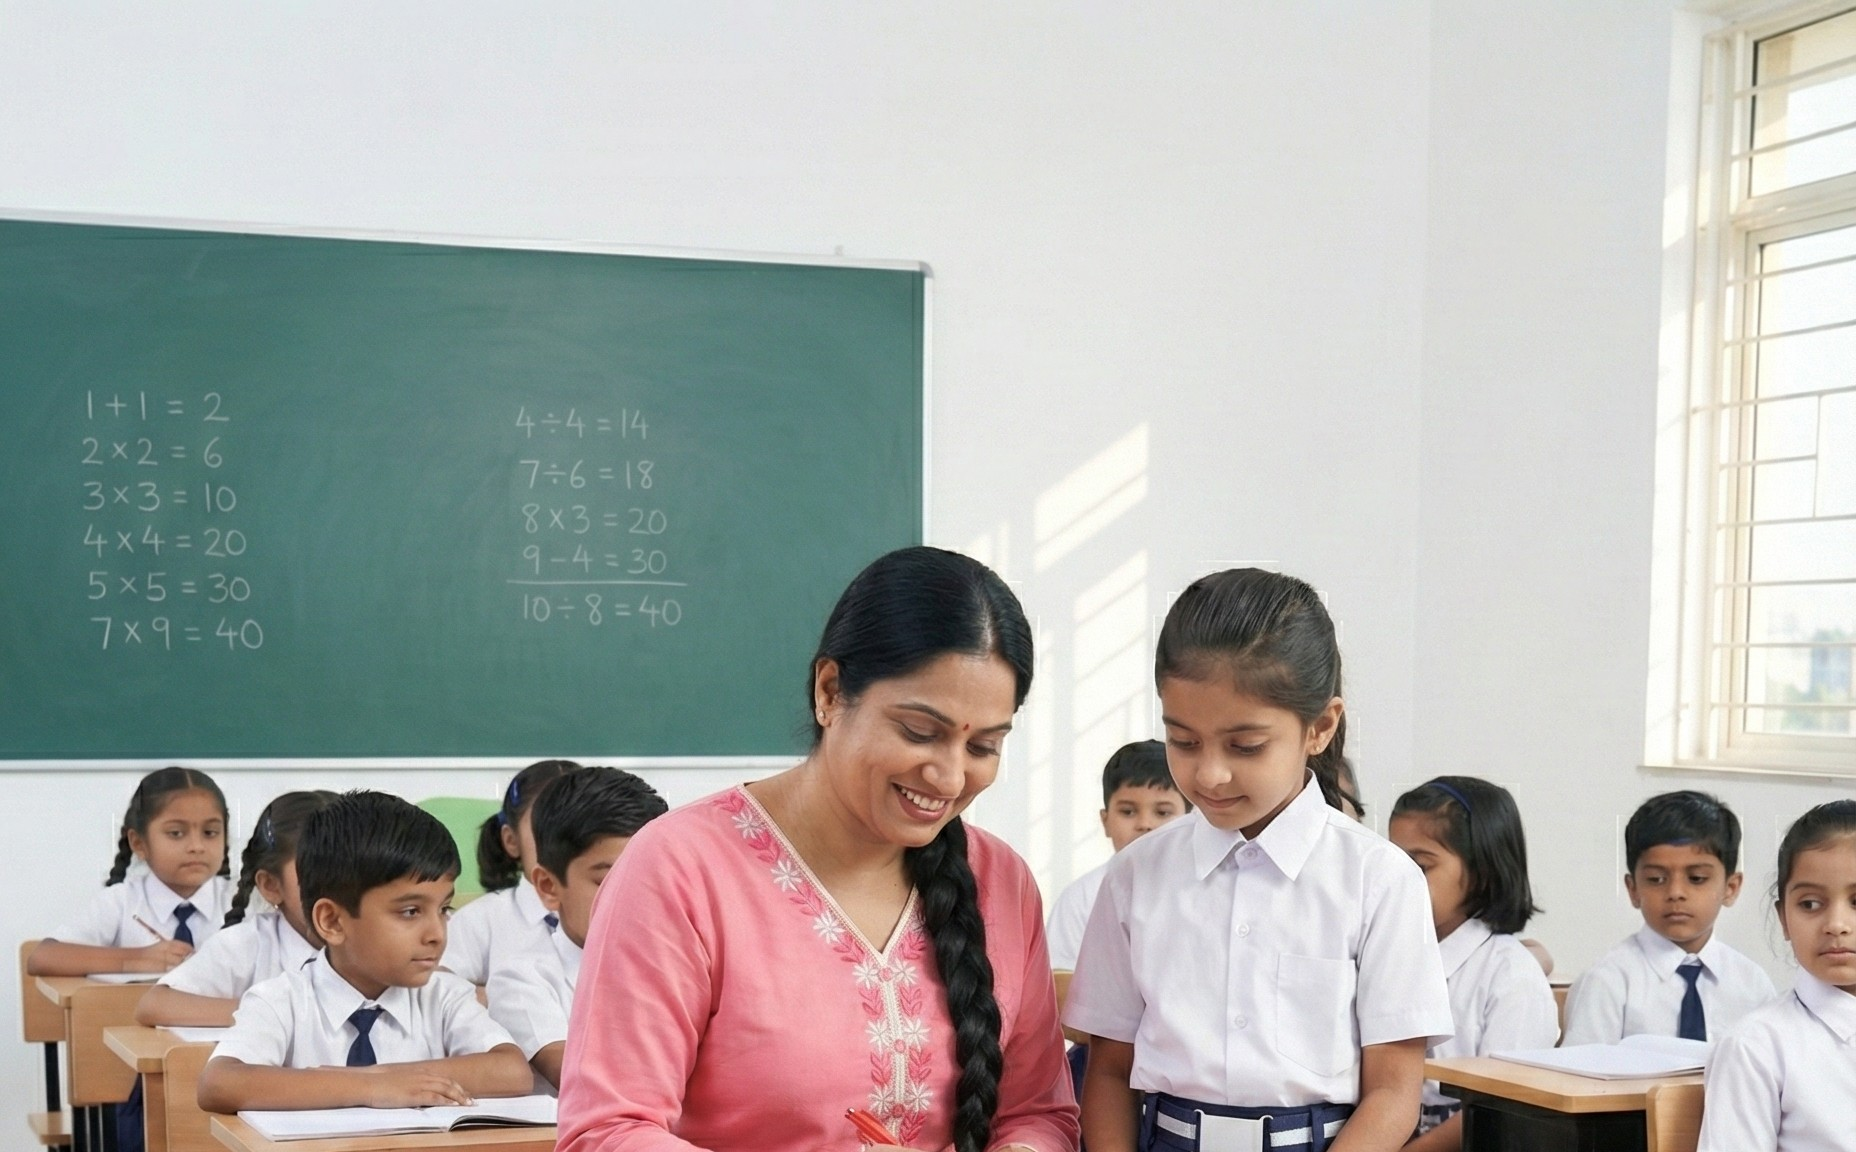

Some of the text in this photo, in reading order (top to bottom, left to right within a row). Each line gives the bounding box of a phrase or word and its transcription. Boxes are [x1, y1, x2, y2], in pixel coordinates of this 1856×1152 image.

[87, 390, 93, 419] 1
[140, 391, 146, 420] 1
[204, 392, 230, 422] 2
[82, 437, 103, 465] 2
[137, 438, 158, 465] 2
[203, 436, 222, 468] 6
[83, 481, 105, 510] 3
[138, 481, 161, 512] 3
[205, 483, 236, 512] 10
[83, 524, 108, 558] 4
[142, 524, 165, 555] 4
[203, 528, 246, 557] 20
[88, 571, 108, 600] 5
[146, 572, 166, 602] 5
[208, 573, 251, 603] 30
[91, 616, 112, 650] 7
[152, 616, 170, 650] 9
[215, 617, 263, 650] 40
